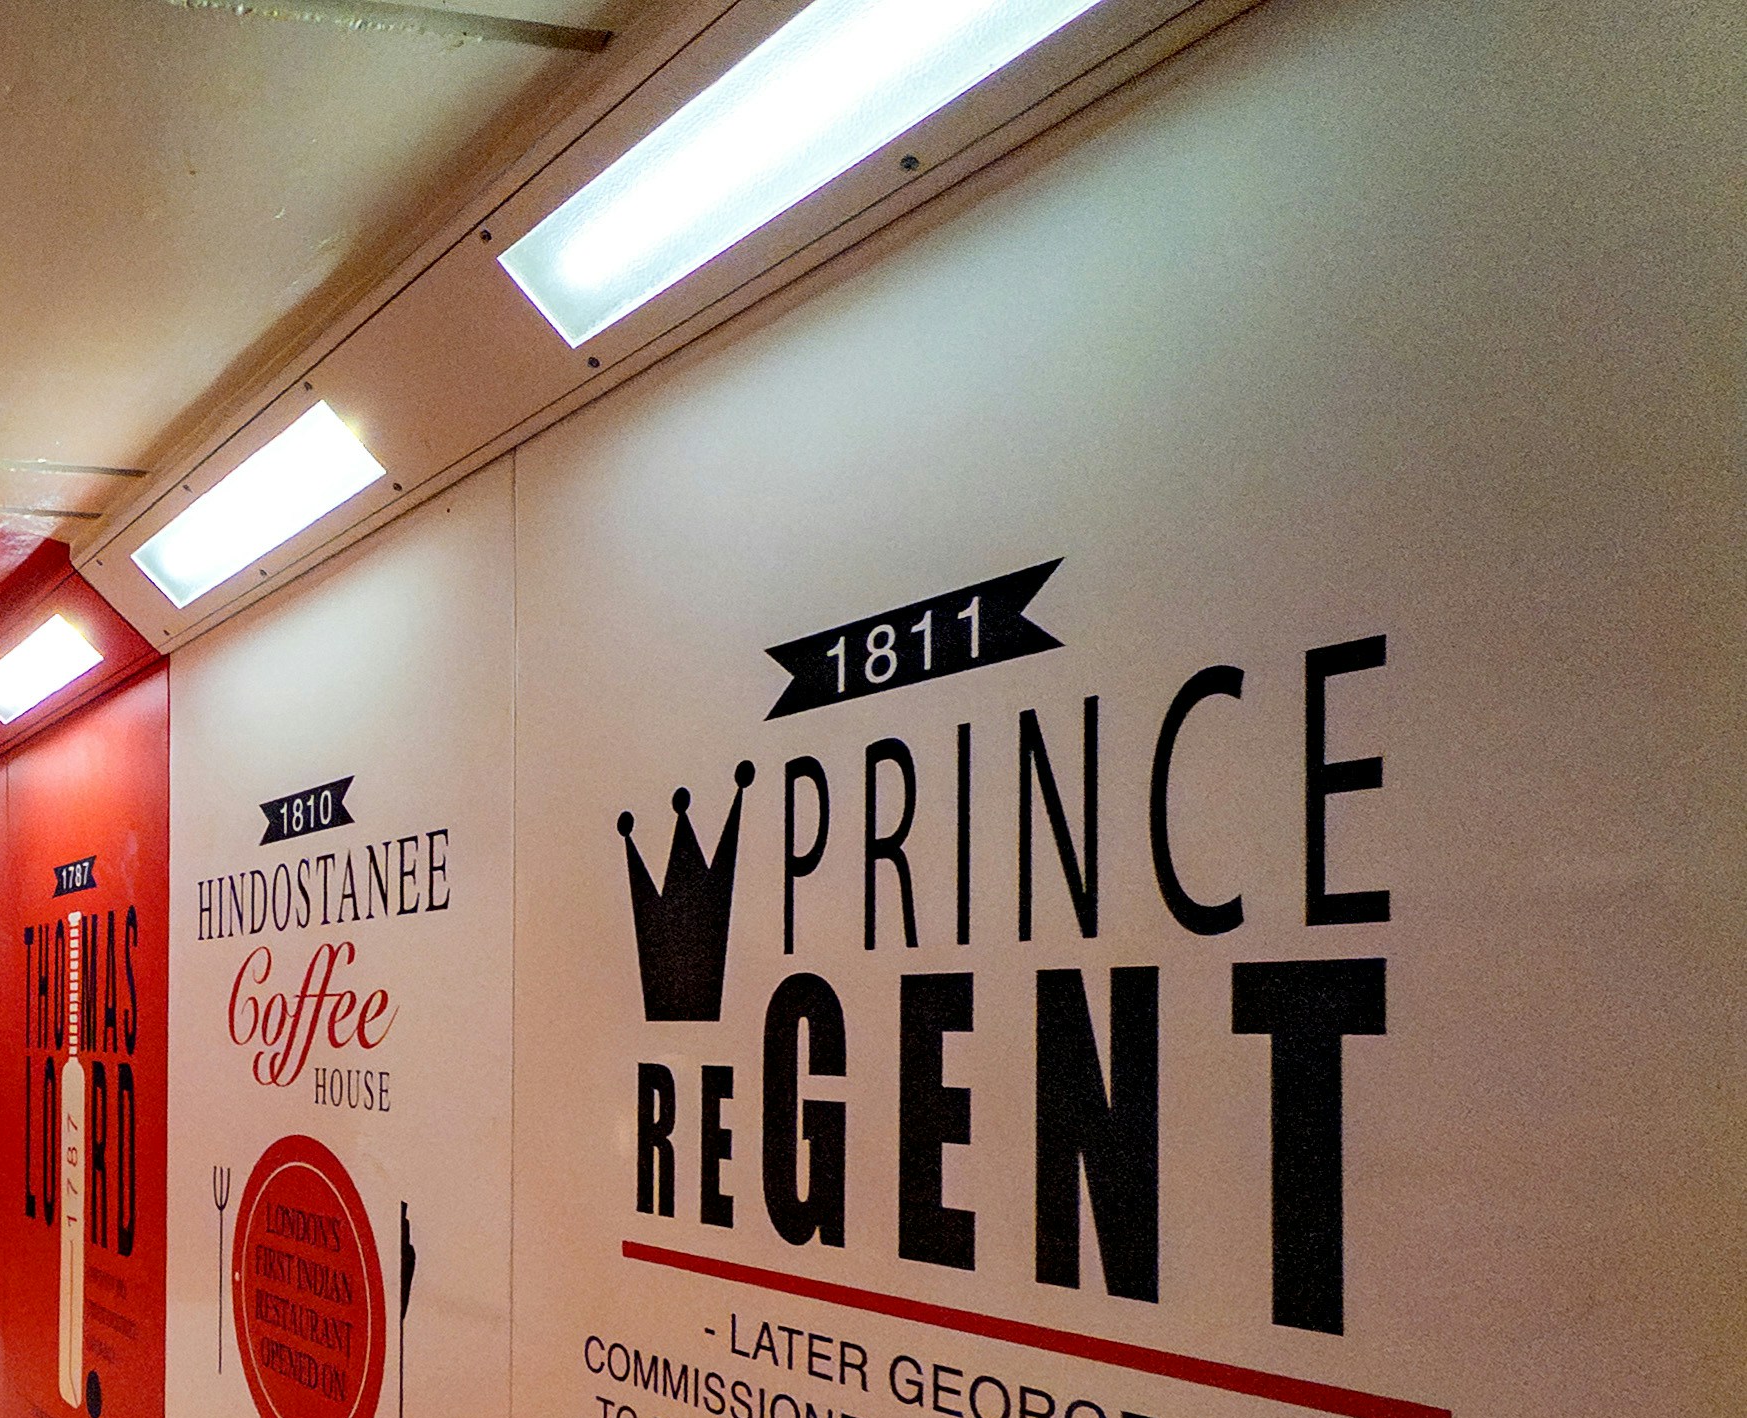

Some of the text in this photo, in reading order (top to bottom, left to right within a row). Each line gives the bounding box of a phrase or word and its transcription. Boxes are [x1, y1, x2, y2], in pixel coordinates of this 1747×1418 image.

[826, 597, 982, 693] 1811
[279, 789, 332, 835] 1810
[783, 634, 1391, 955] PRINCE
[61, 861, 90, 888] 1787
[198, 829, 451, 940] HINDOSTANEE
[25, 904, 138, 1055] THOMAS
[228, 941, 400, 1087] Coffee
[314, 1067, 391, 1113] HOUSE
[66, 1113, 79, 1226] 1787
[636, 958, 1387, 1337] REGENT
[266, 1202, 341, 1252] LONDON'S
[255, 1244, 352, 1304] FIRST INDIAN
[255, 1288, 354, 1362] RESTAURANT
[730, 1313, 870, 1392] LATER
[261, 1336, 346, 1402] OPENED ON
